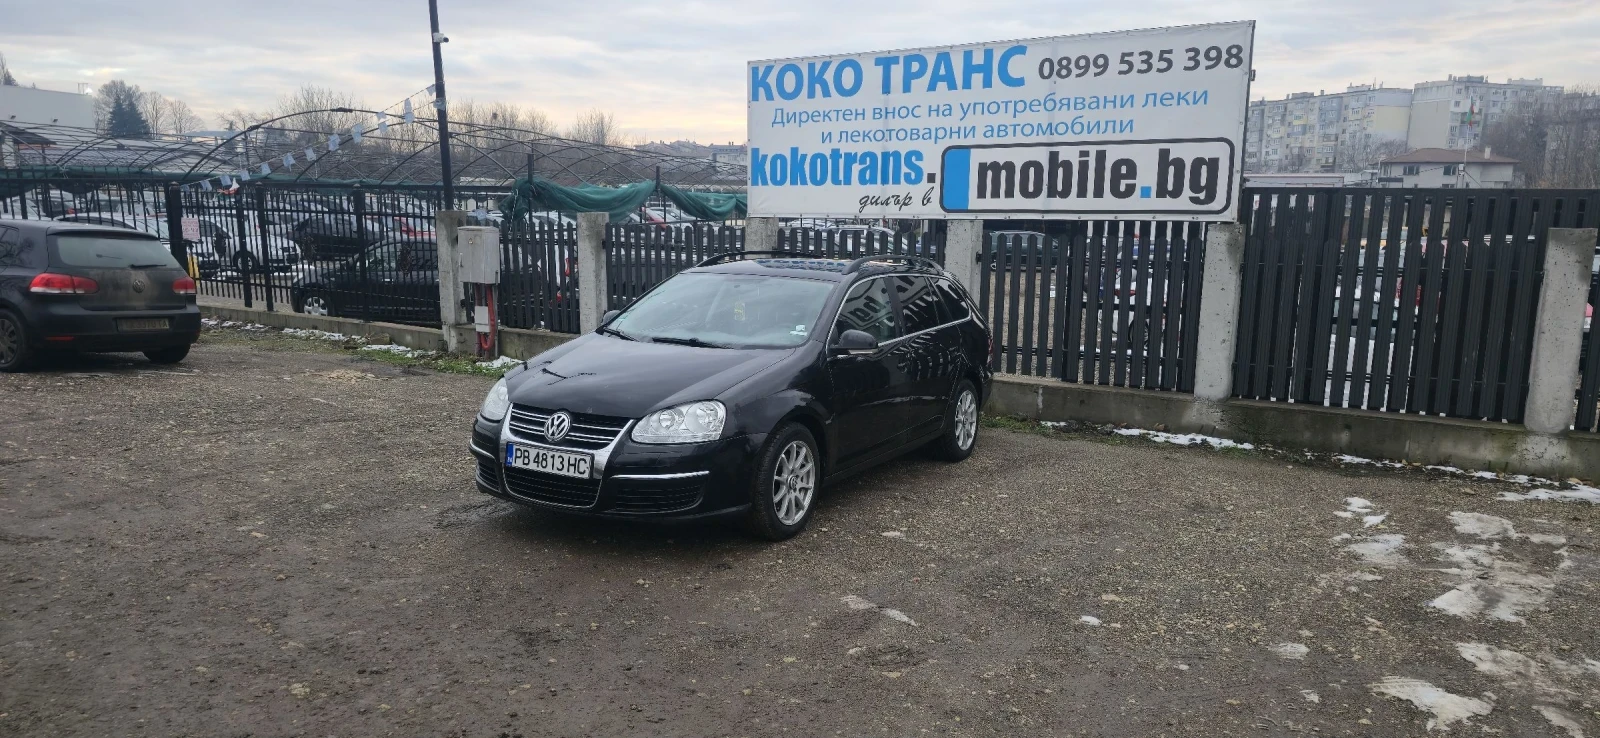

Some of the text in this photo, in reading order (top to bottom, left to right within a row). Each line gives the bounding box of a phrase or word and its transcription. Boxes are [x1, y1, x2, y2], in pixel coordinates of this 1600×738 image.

[751, 44, 1028, 102] КОКО ТРАНС
[1038, 44, 1244, 80] 0899 535 398
[771, 89, 1209, 128] Директен внос на употребявани леки
[820, 115, 1134, 145] и лекотоварни автомобили
[976, 148, 1220, 206] mobile.bg
[858, 186, 935, 213] дилър в
[514, 448, 587, 475] PB 4813 HC
